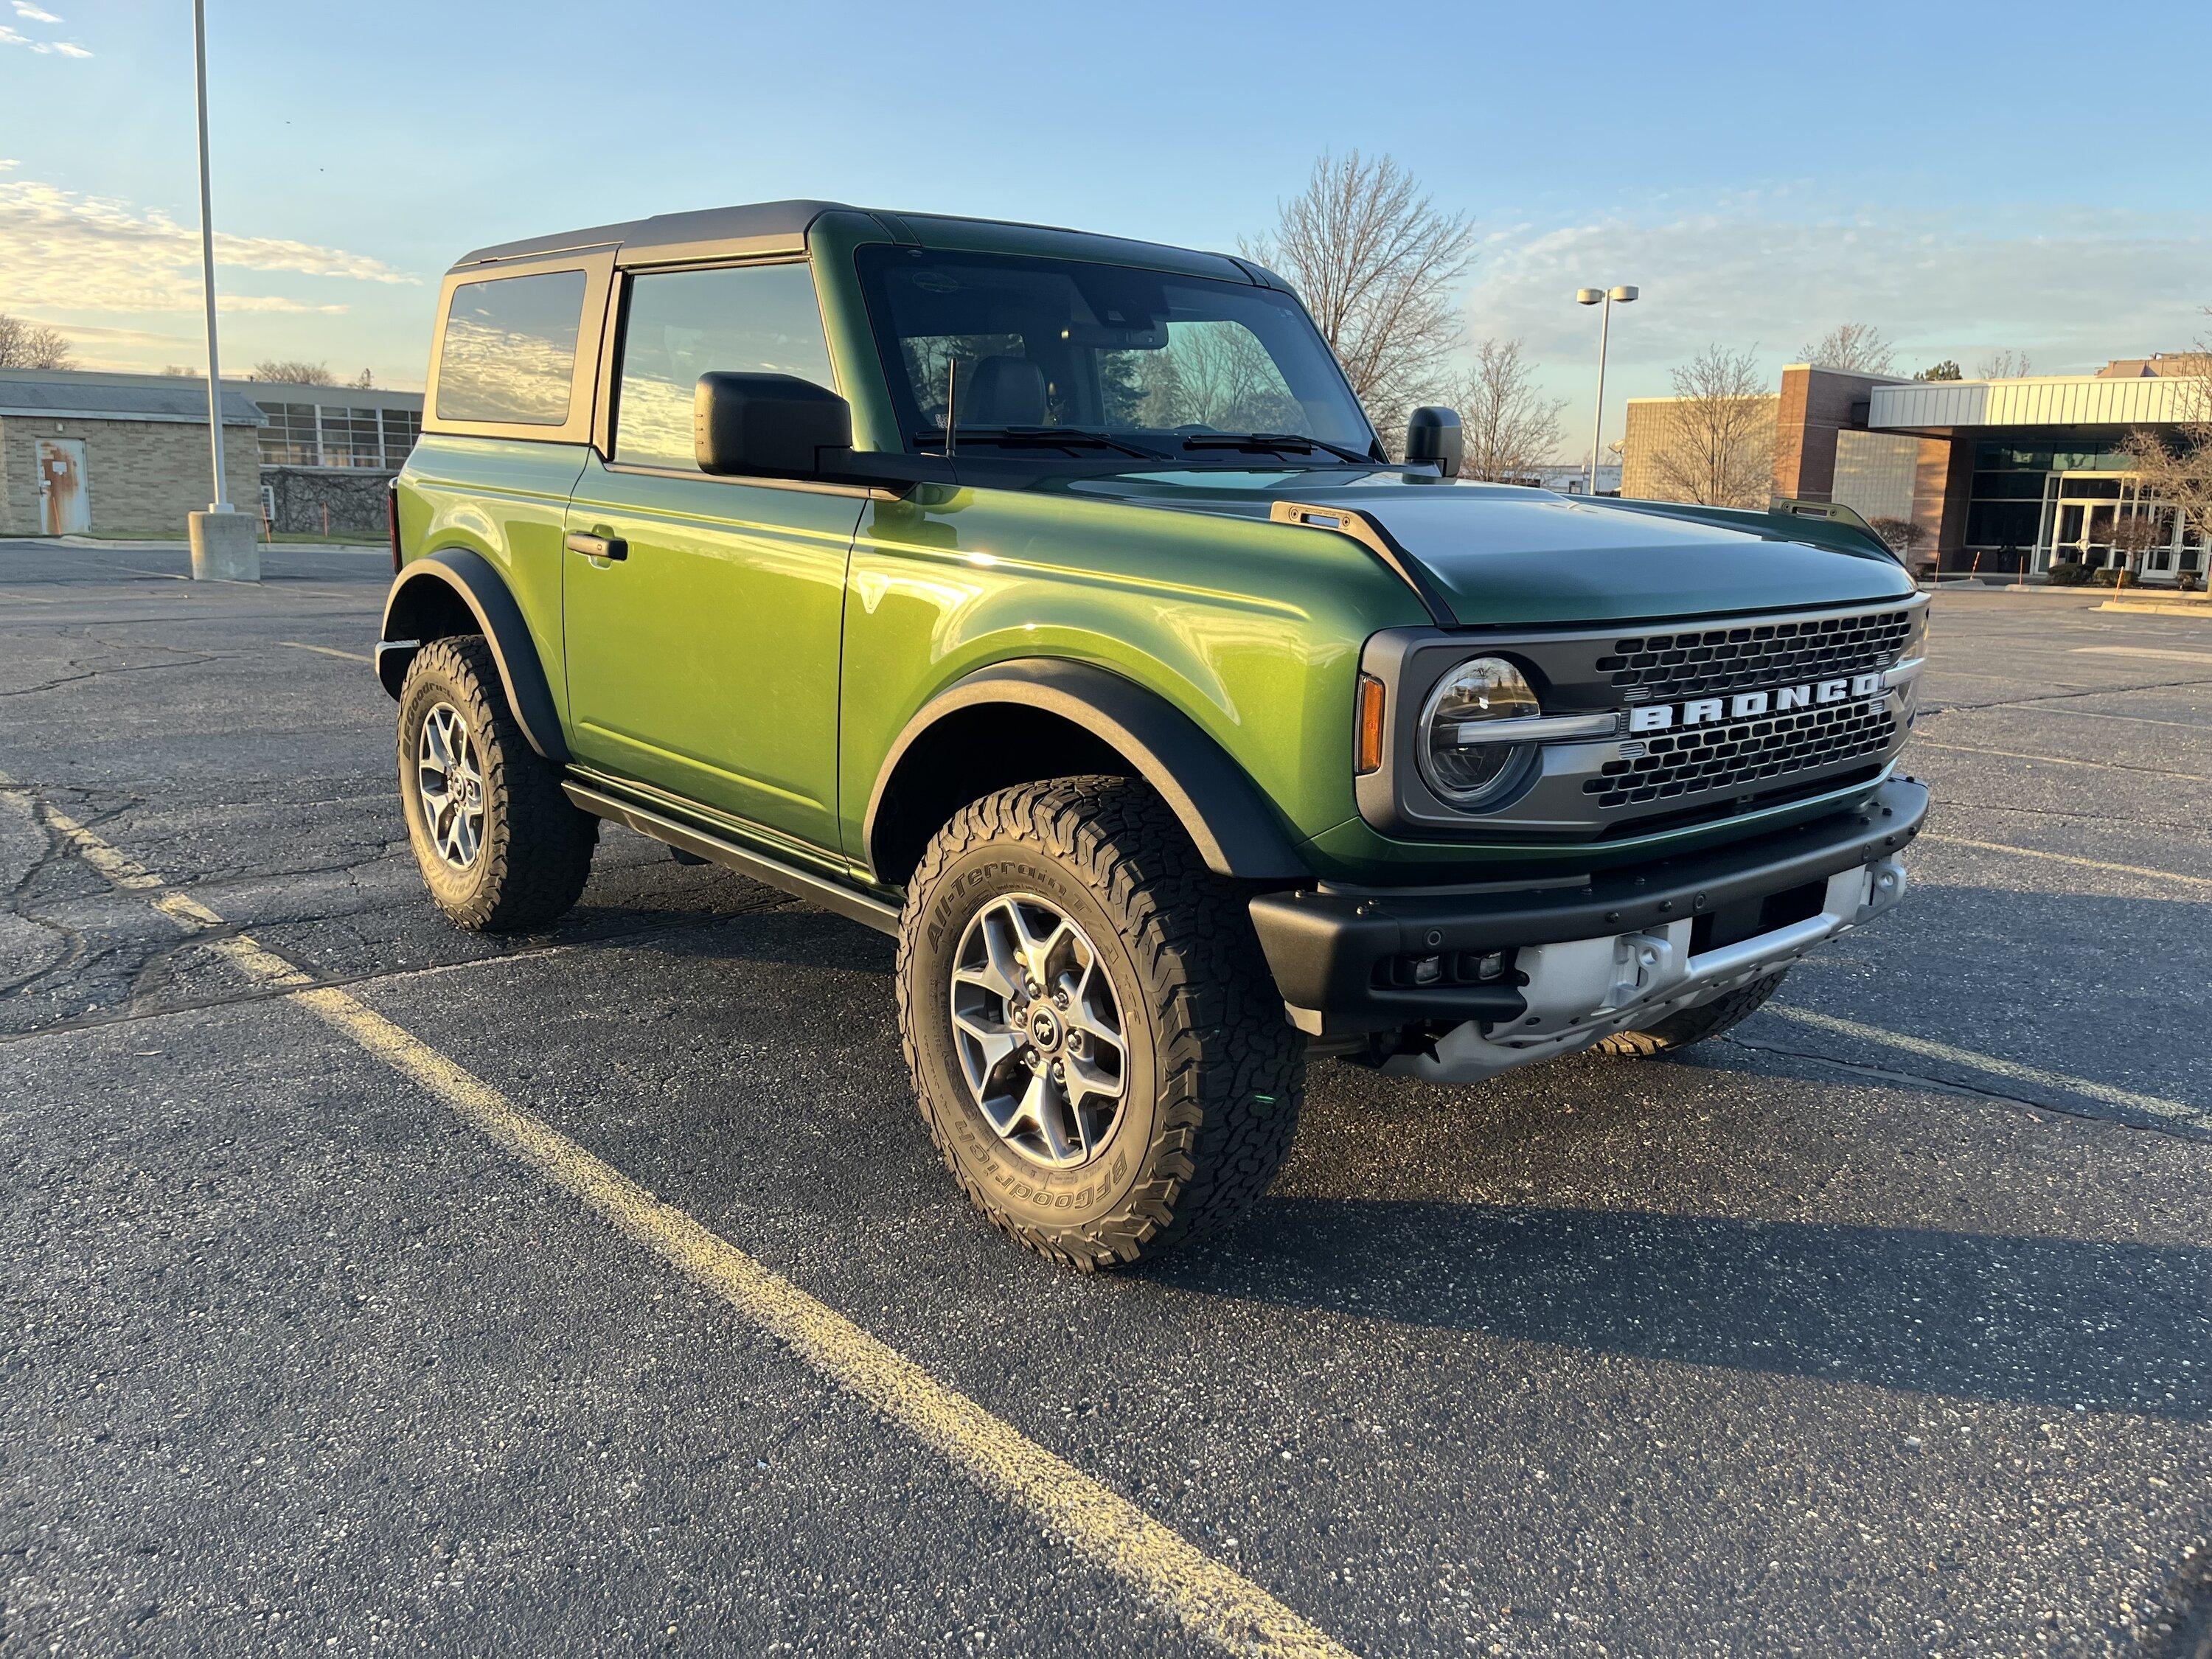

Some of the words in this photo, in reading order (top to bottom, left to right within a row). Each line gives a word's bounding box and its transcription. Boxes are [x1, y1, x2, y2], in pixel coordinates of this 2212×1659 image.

[1630, 673, 1880, 732] BRONCO
[927, 860, 1067, 954] All-Terrain
[955, 1121, 1127, 1210] BFGoodrich
